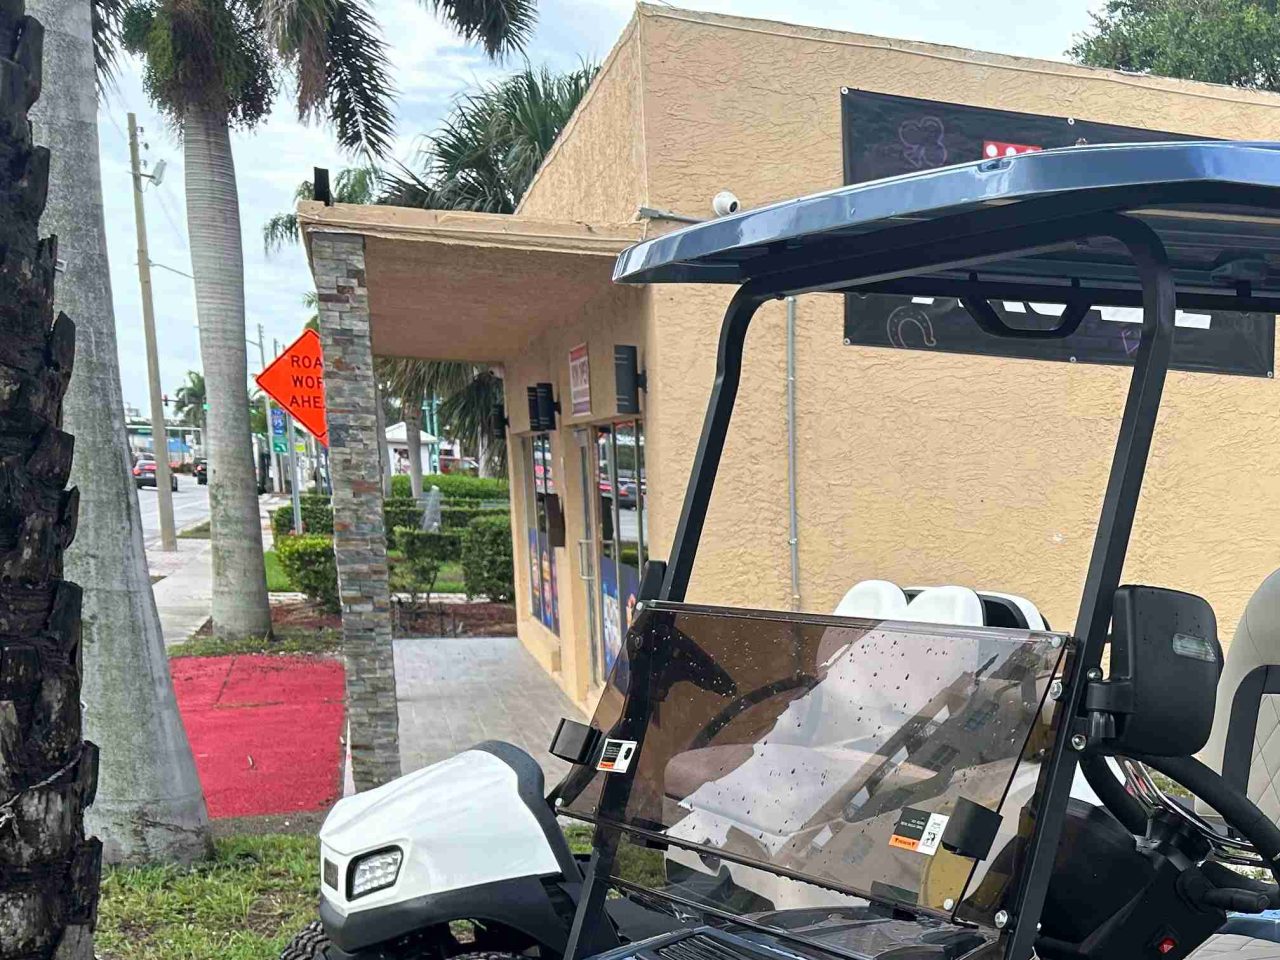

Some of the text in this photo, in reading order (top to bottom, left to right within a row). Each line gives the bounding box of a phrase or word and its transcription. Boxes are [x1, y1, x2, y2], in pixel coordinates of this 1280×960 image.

[291, 355, 323, 369] ROA
[292, 374, 323, 389] WOR
[289, 395, 325, 409] AHE
